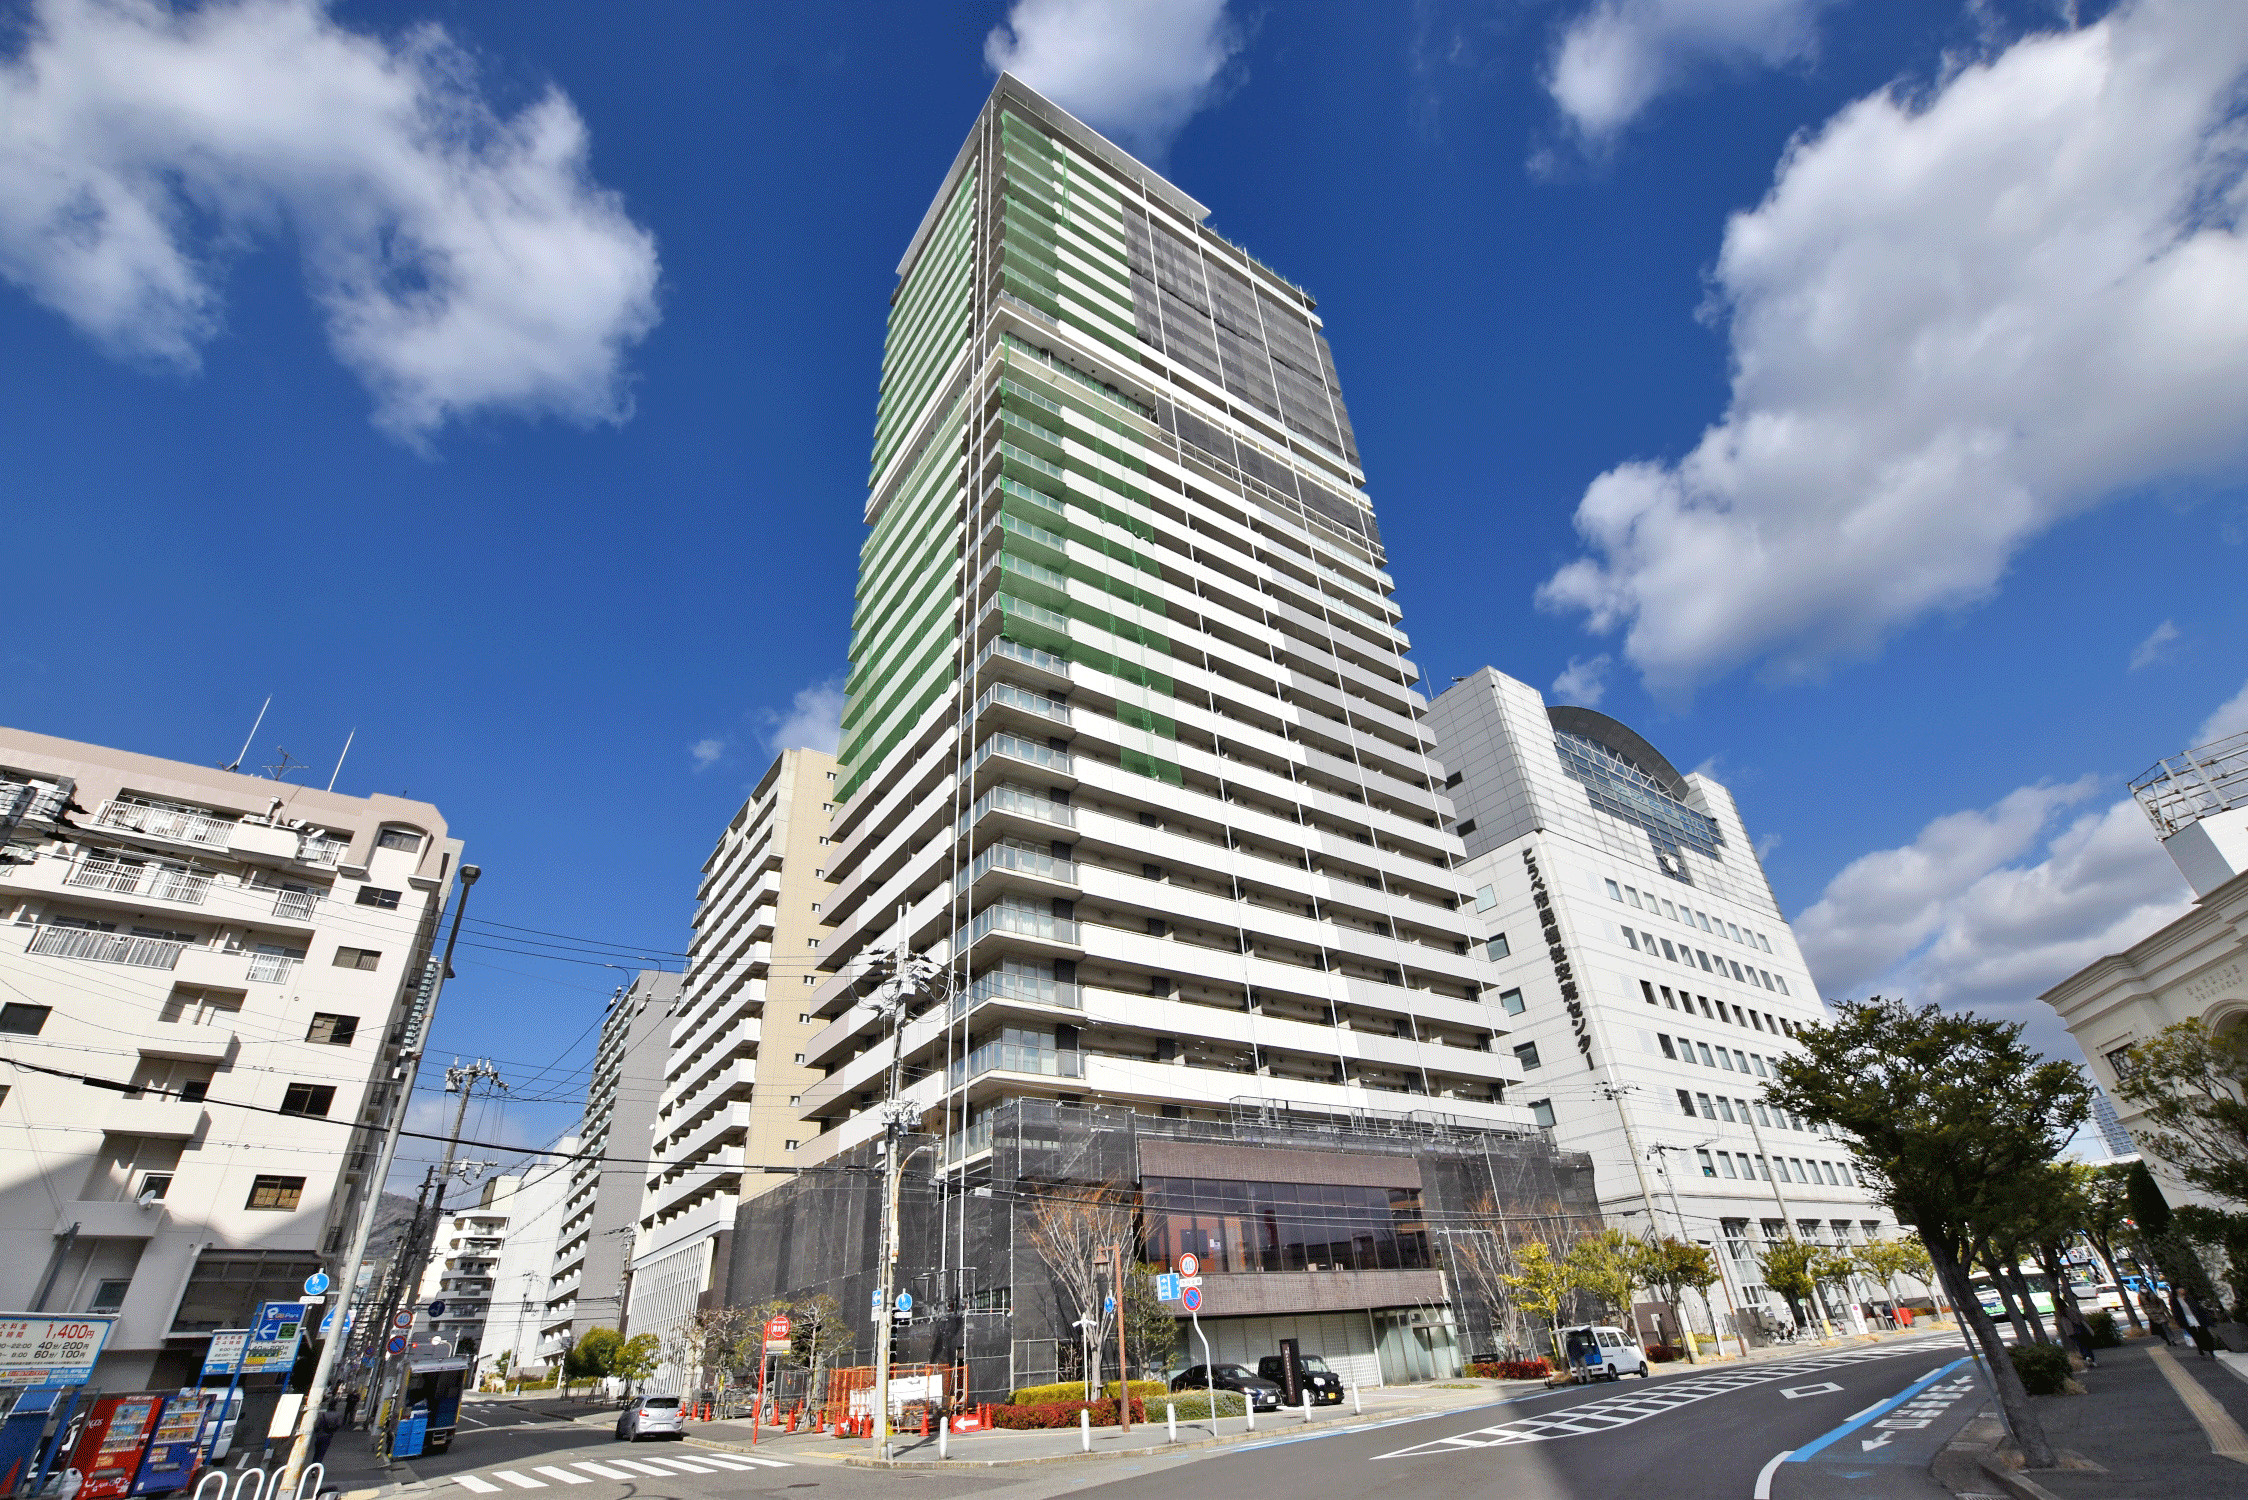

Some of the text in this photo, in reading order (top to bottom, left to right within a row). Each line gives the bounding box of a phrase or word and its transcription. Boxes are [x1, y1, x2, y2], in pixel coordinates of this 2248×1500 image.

[1522, 847, 1595, 1071] こうべ市民福祉交流センター
[1184, 1260, 1194, 1271] 40
[398, 1315, 409, 1323] 40
[46, 1324, 95, 1339] 1,400円
